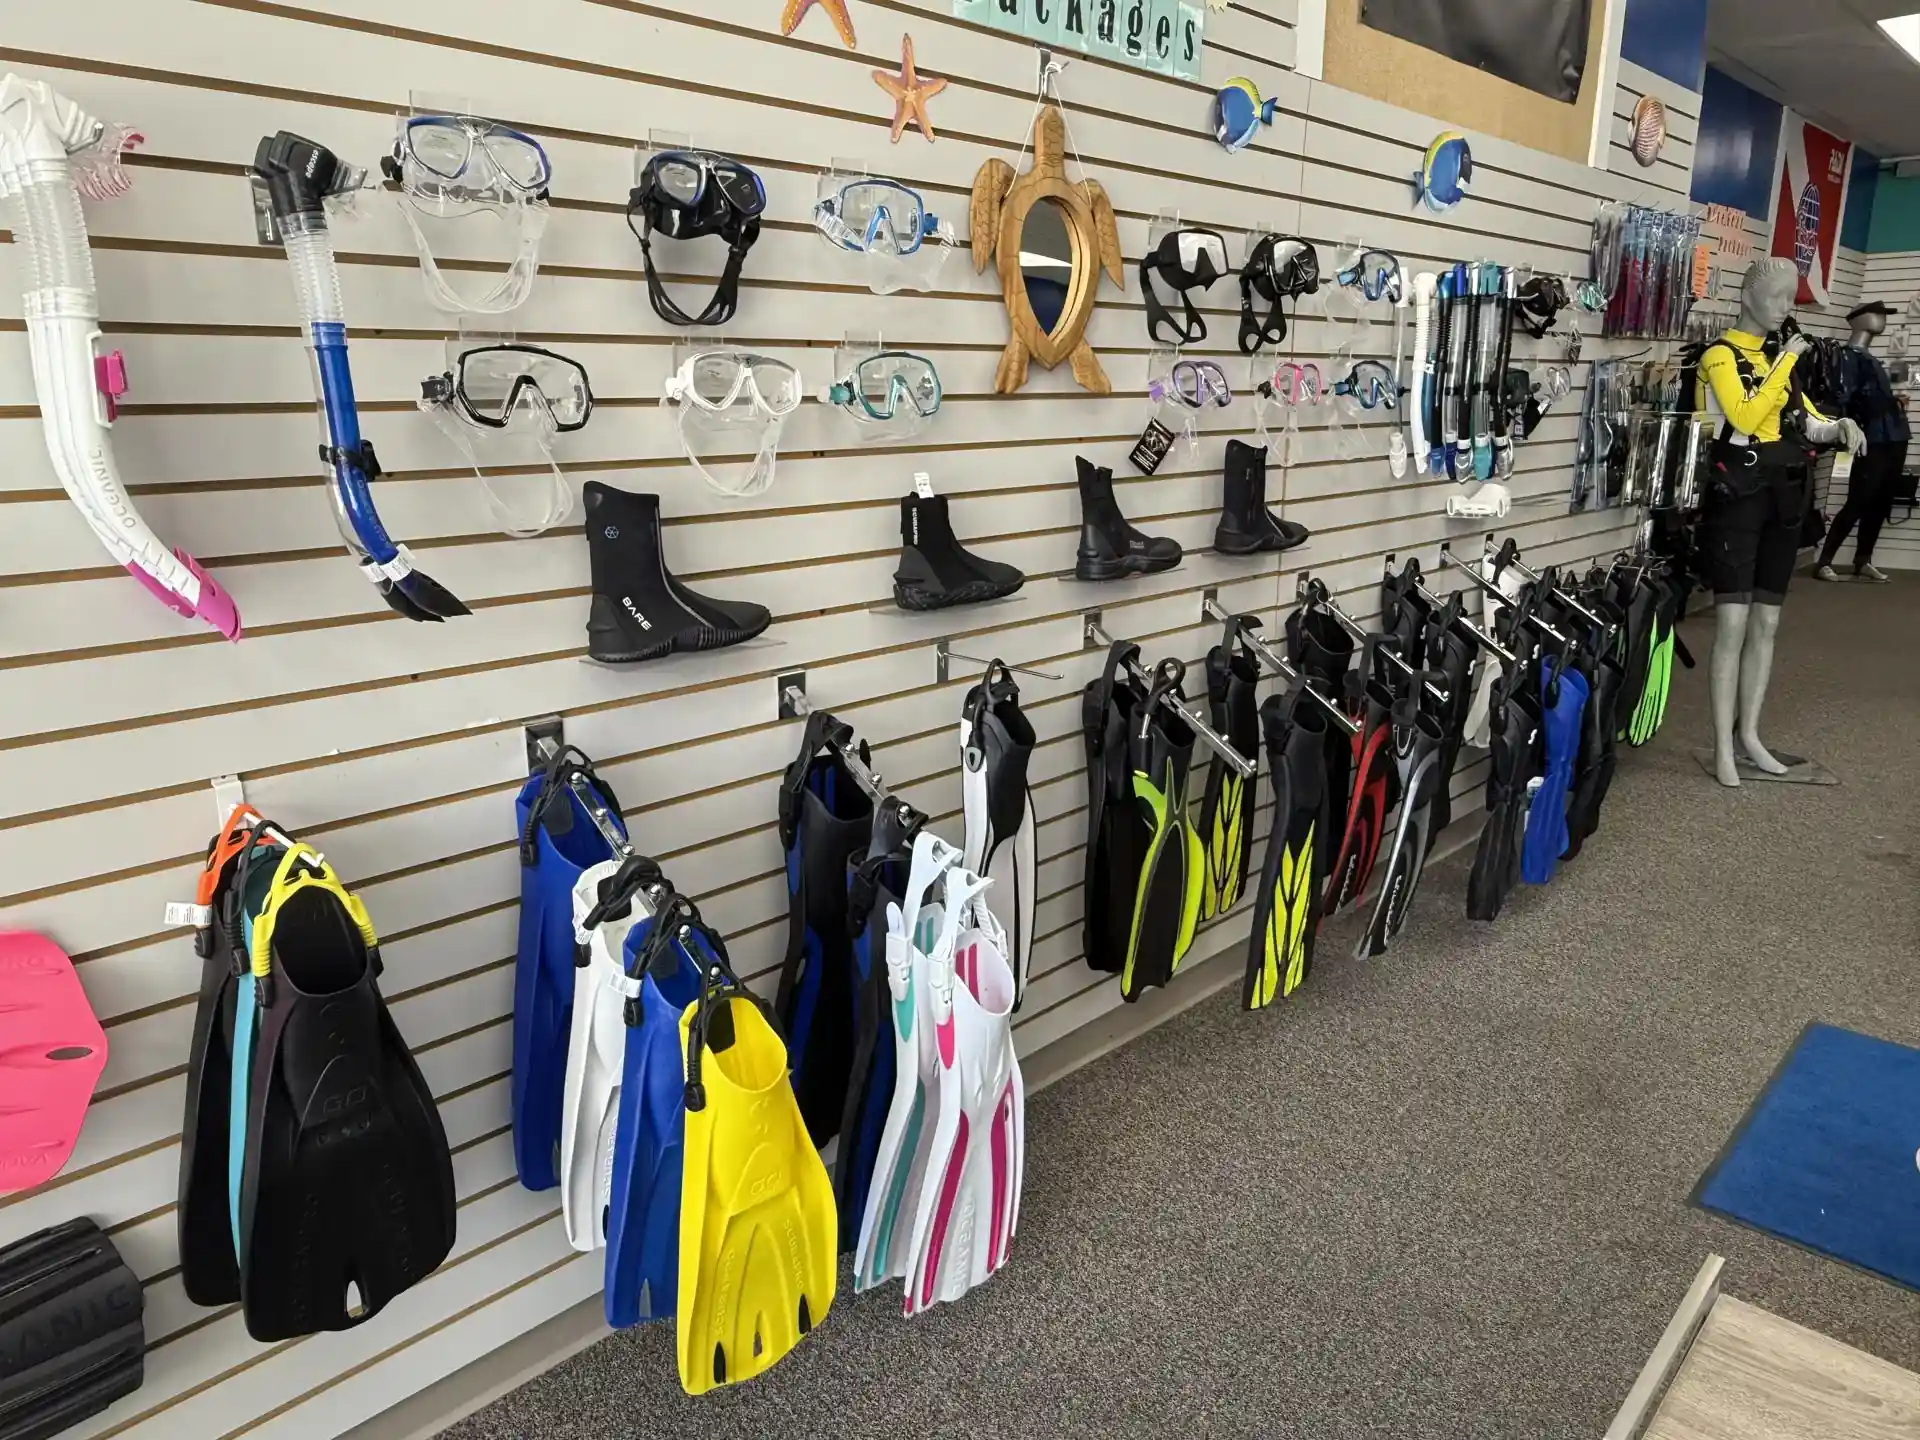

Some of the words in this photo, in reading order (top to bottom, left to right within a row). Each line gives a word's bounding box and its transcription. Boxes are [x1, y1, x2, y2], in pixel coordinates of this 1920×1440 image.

[966, 0, 1196, 62] ckages
[89, 448, 136, 528] OCEANIC
[622, 596, 652, 631] BARE
